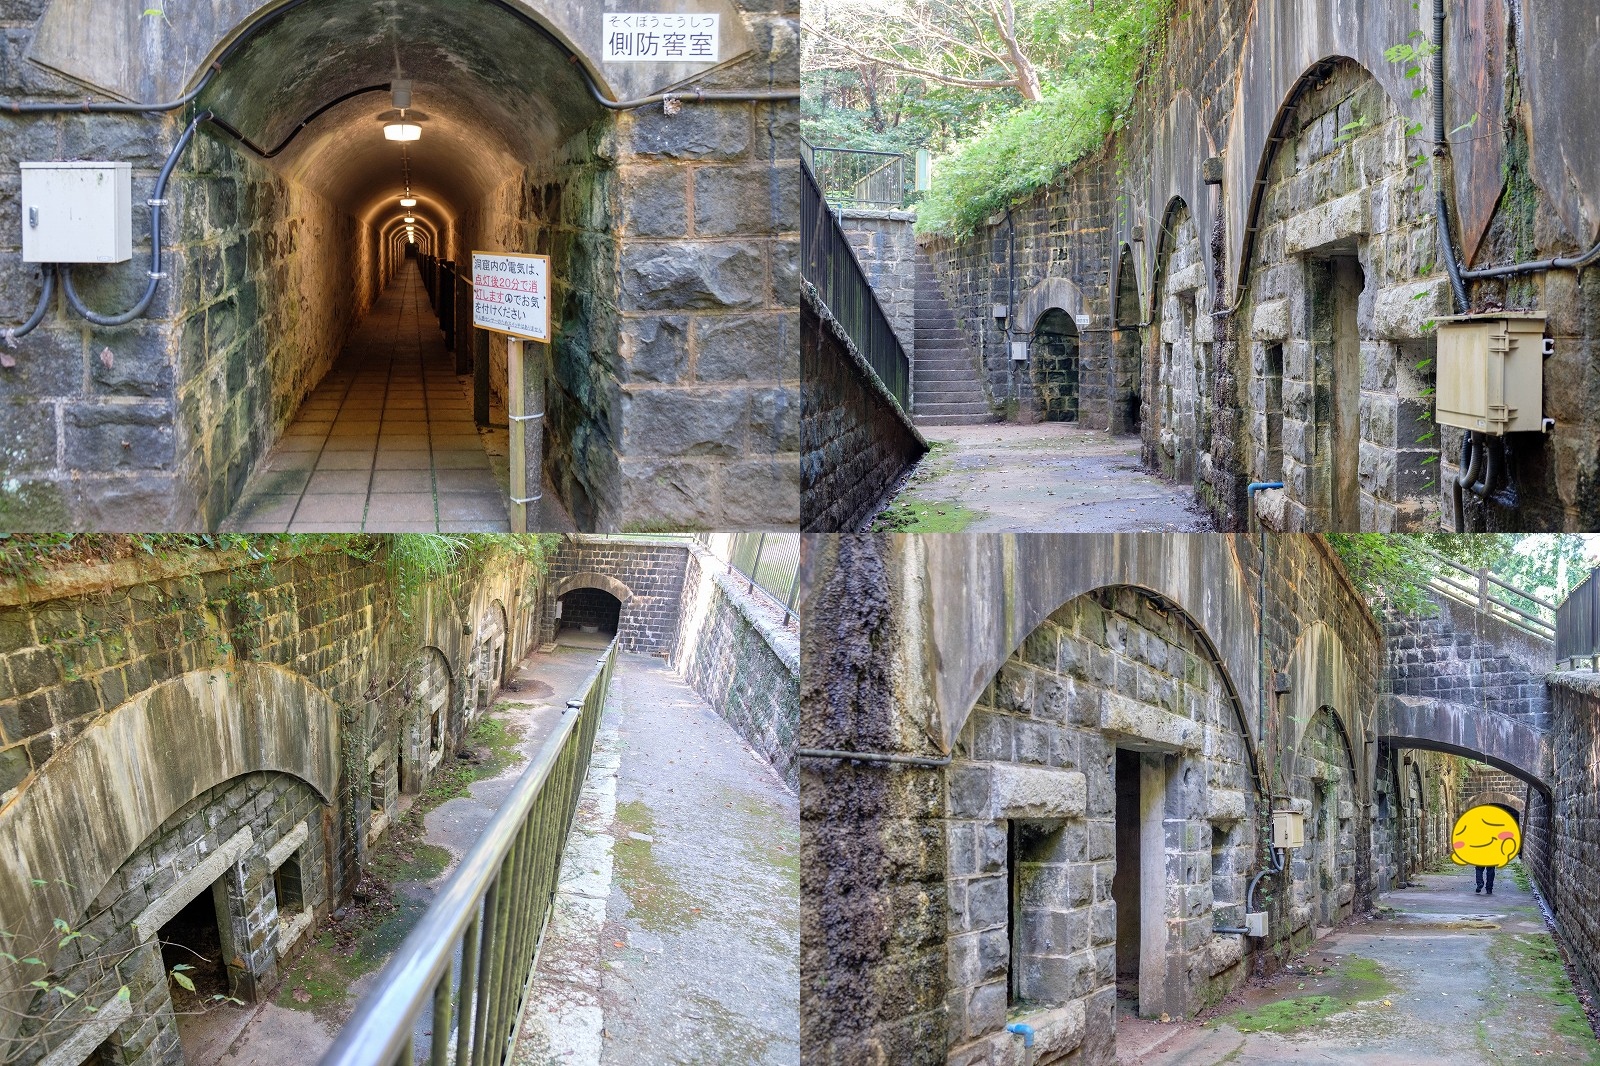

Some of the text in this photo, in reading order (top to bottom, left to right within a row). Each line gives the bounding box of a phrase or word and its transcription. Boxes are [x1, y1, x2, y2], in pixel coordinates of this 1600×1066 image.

[609, 16, 714, 28] そくぼうこうしつ
[608, 32, 713, 56] 側防窖室
[475, 259, 539, 276] 洞窟内の電気は、
[475, 274, 538, 293] 点灯後20分で消
[475, 288, 539, 309] 灯しますのでお気
[475, 302, 526, 320] を付けください
